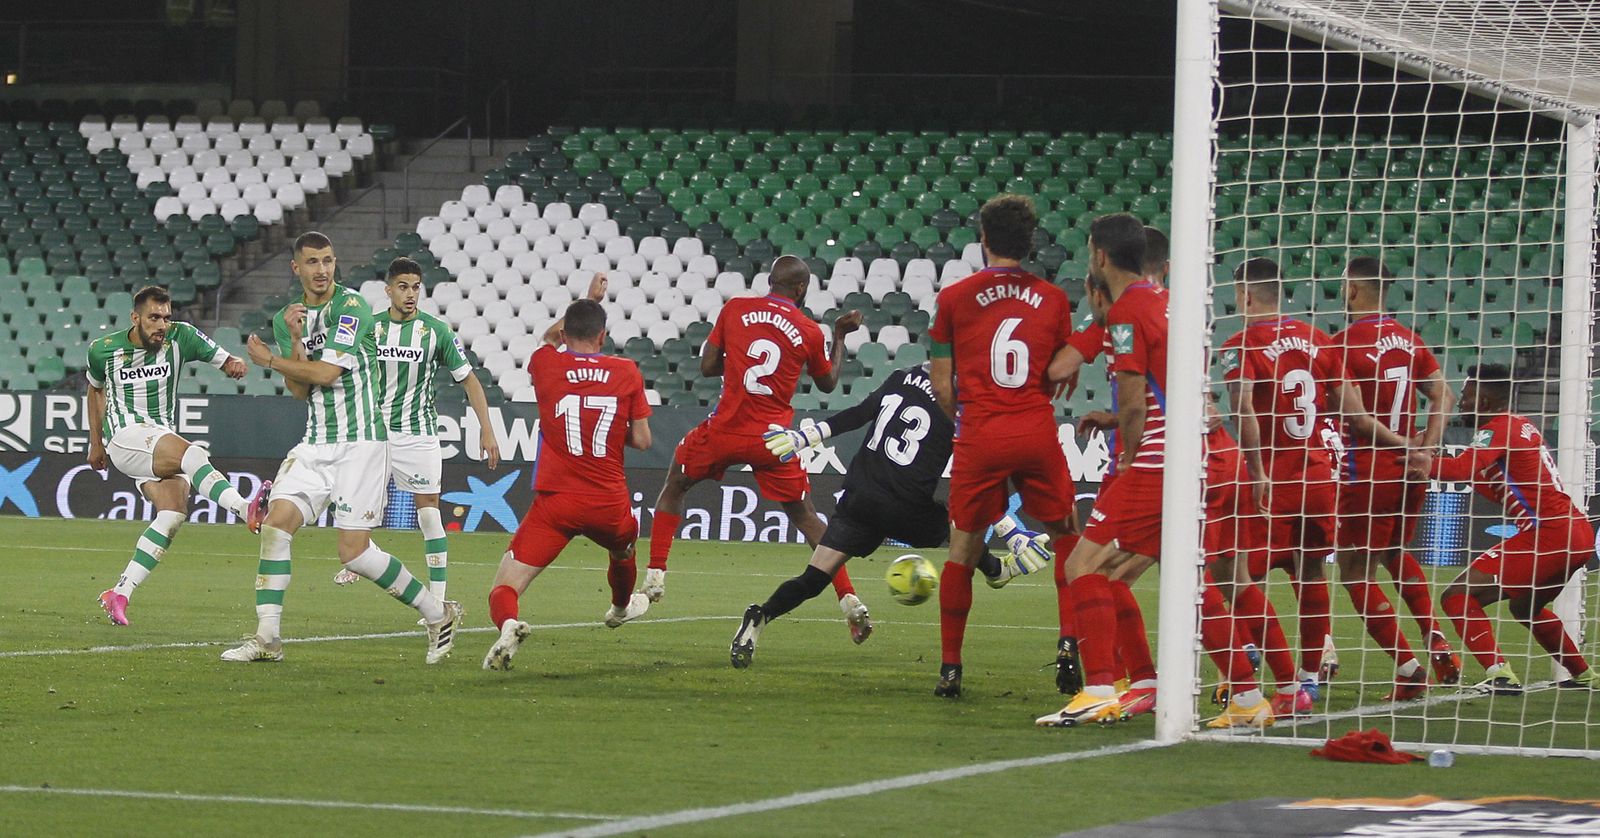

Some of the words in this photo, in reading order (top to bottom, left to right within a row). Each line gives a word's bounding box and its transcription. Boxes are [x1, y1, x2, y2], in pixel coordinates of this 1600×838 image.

[976, 284, 1043, 309] GERMÁN
[741, 311, 804, 348] FOULQUIER
[376, 345, 423, 362] betway
[743, 338, 782, 395] 2
[990, 317, 1030, 389] 6
[1263, 336, 1319, 362] NEHUEN
[120, 364, 170, 381] betway
[566, 367, 611, 384] QUINI
[903, 373, 936, 402] AAR
[1281, 368, 1317, 440] 3
[1383, 366, 1409, 432] 7
[554, 393, 618, 458] 17
[866, 393, 932, 467] 13
